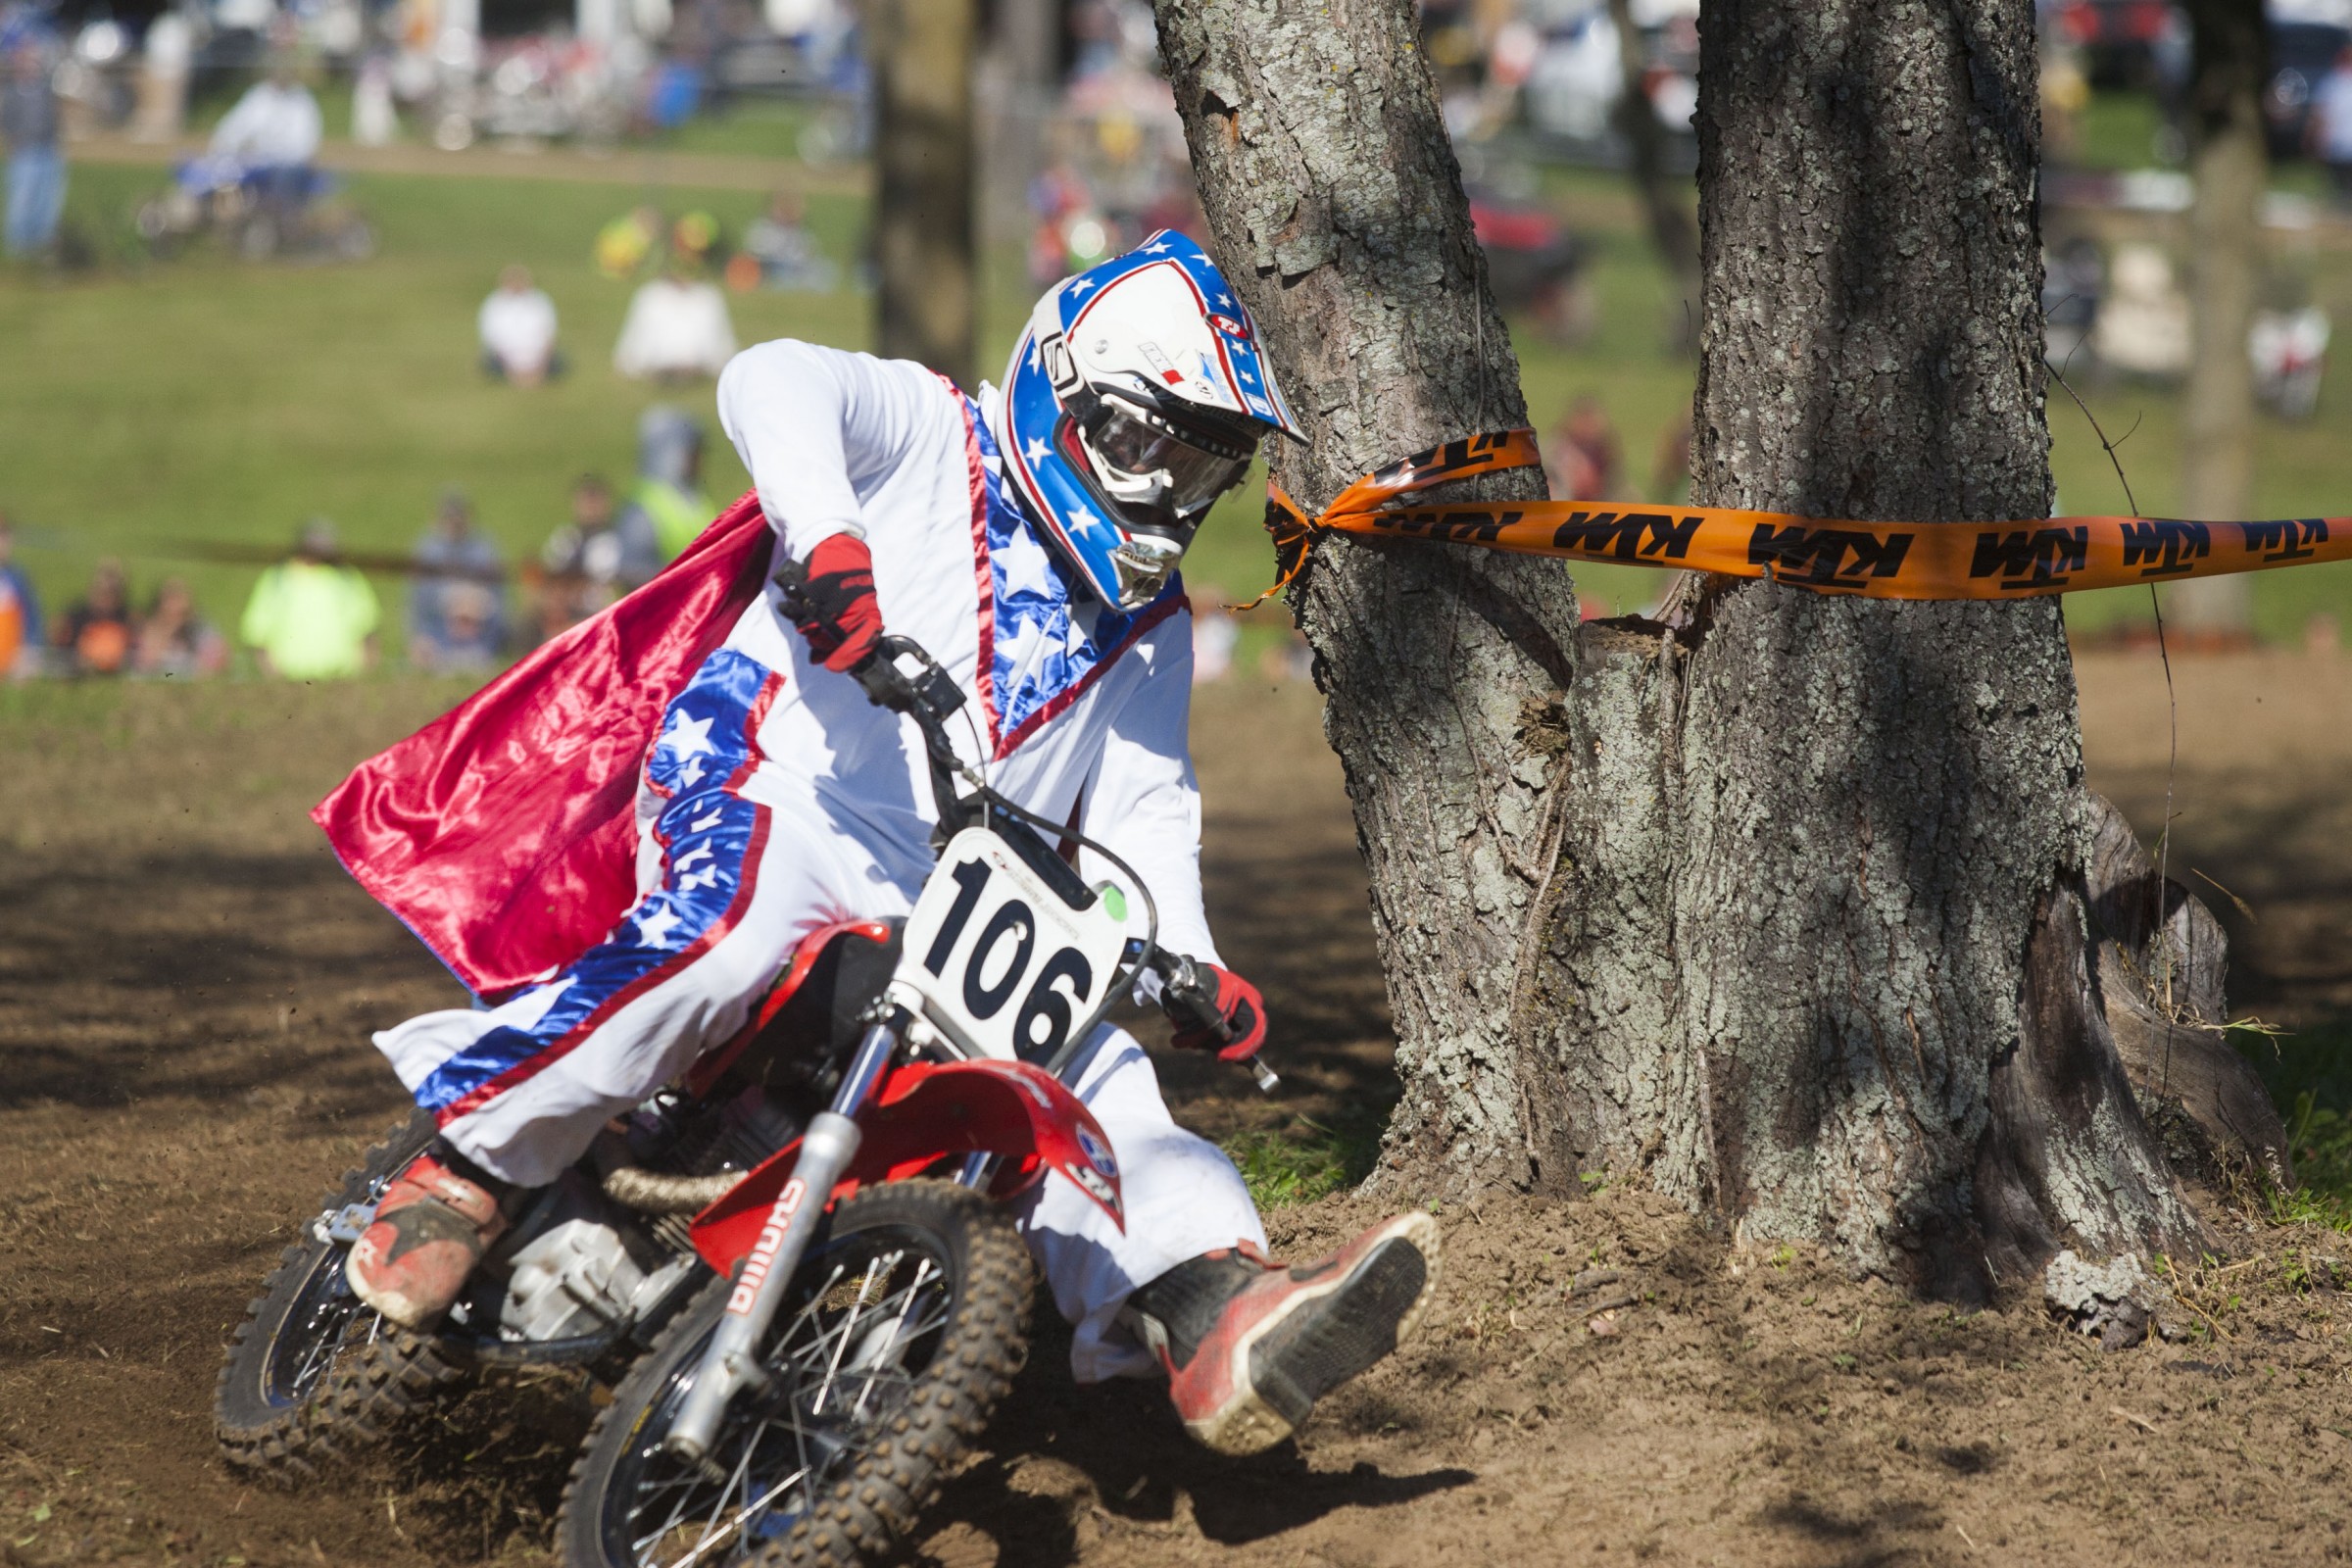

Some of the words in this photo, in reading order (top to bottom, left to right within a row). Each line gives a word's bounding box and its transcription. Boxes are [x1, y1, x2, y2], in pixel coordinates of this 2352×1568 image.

[1748, 523, 1915, 589] KTM
[1969, 526, 2088, 590] KTM
[2119, 521, 2211, 577] KTM
[2239, 517, 2329, 563] KTM
[923, 857, 1093, 1069] 106
